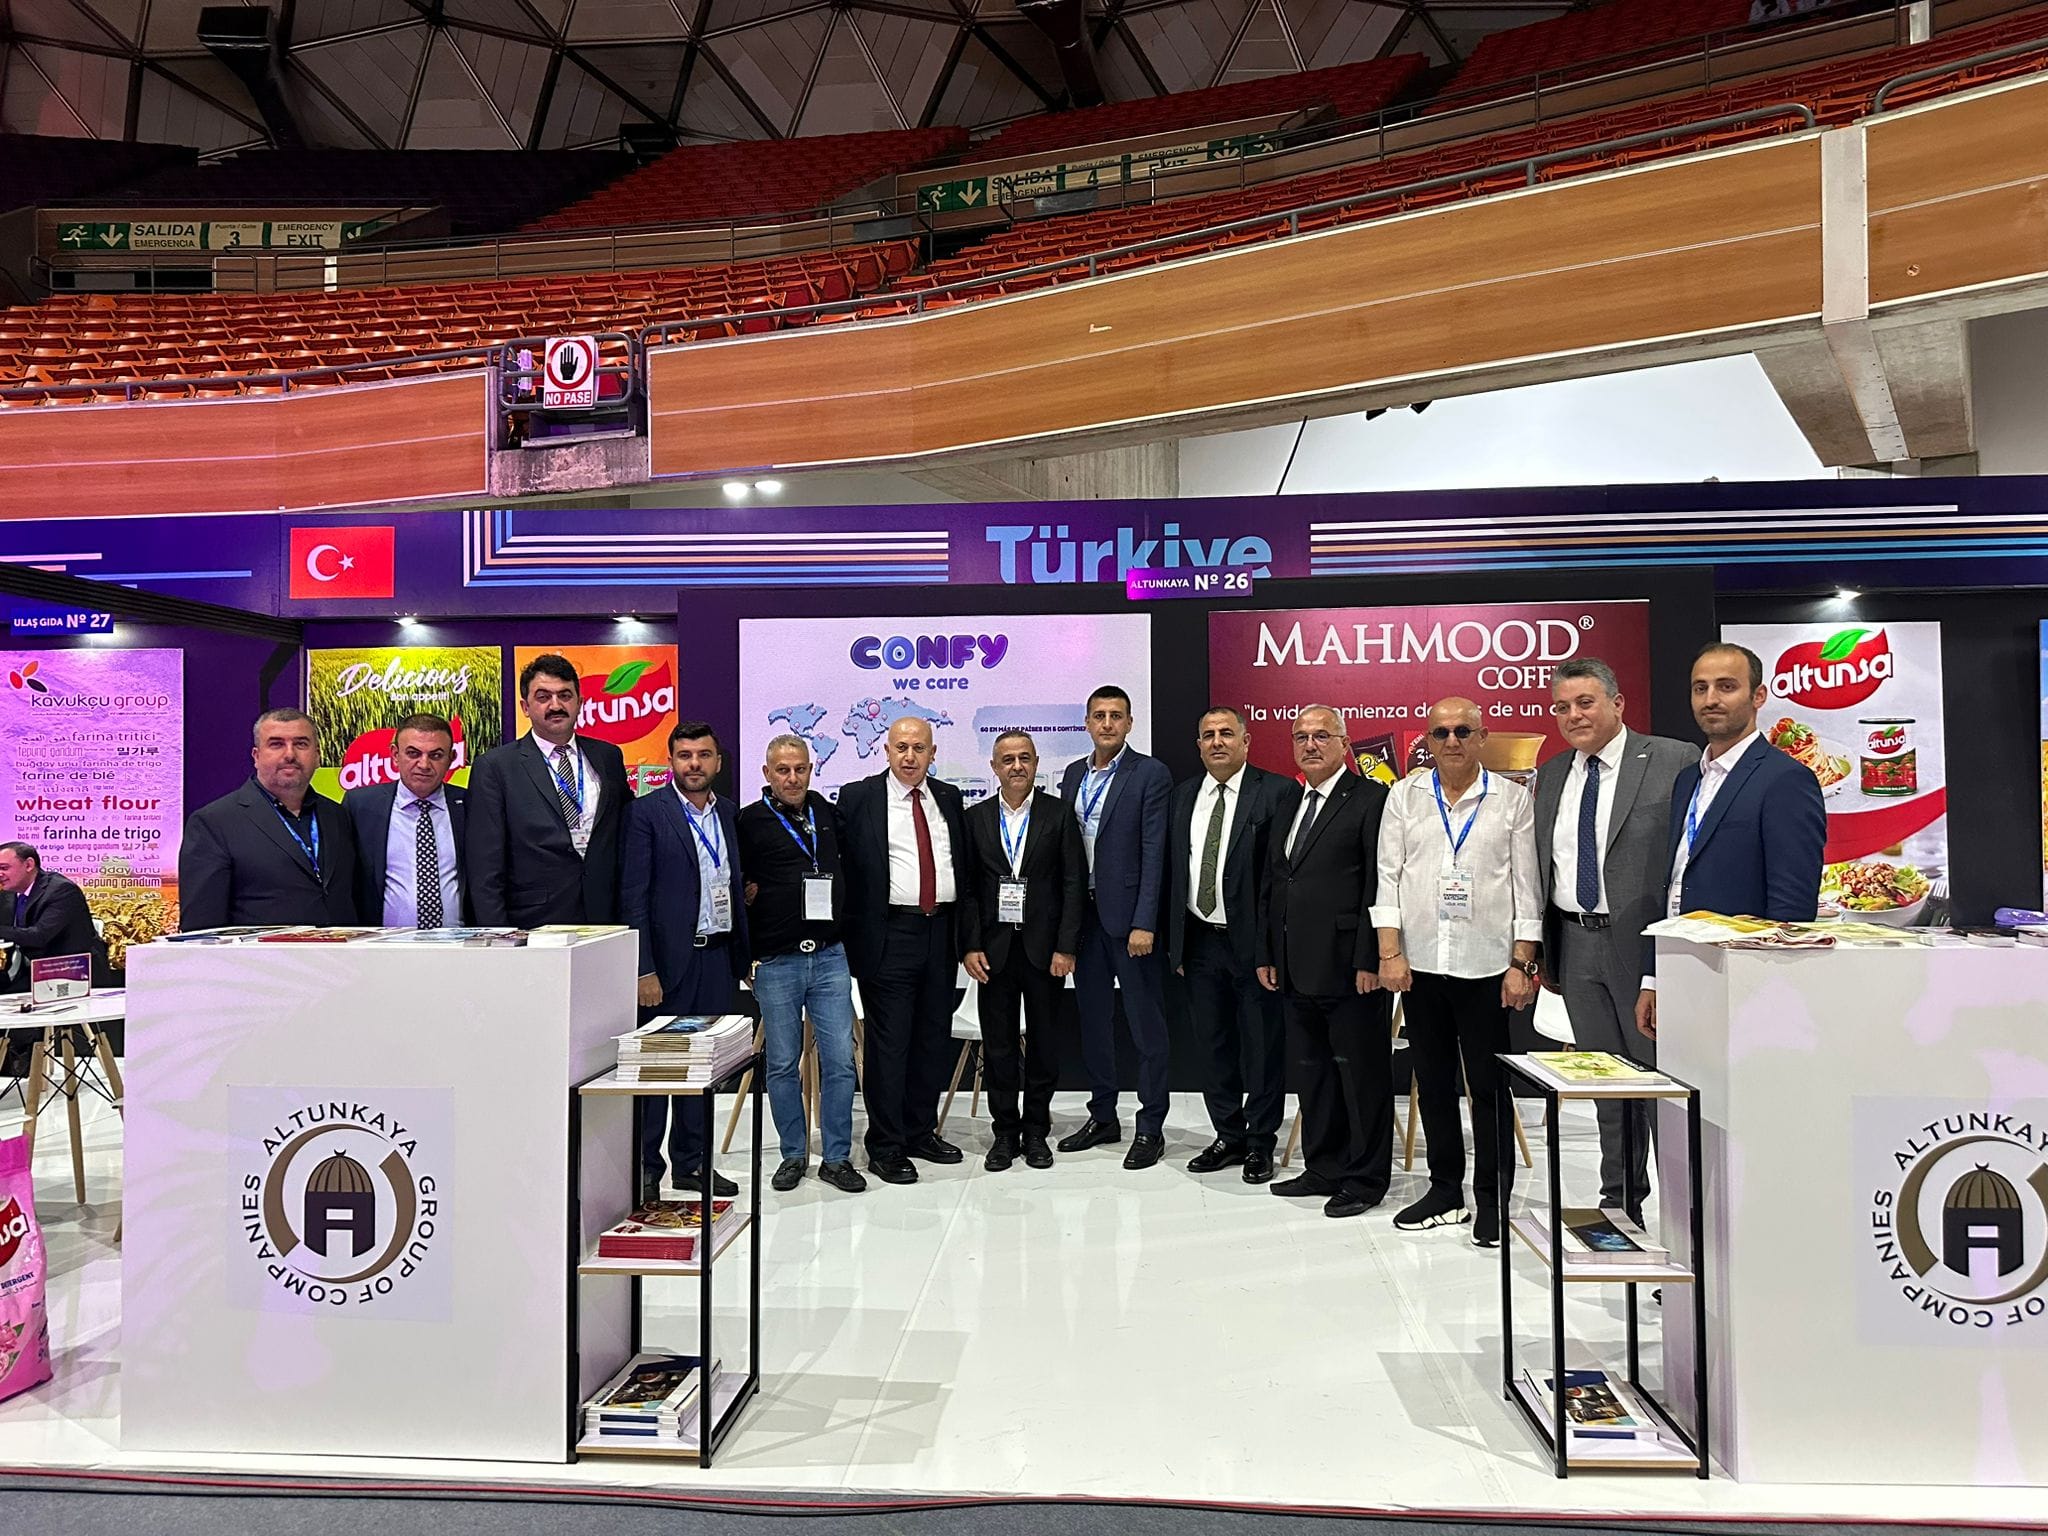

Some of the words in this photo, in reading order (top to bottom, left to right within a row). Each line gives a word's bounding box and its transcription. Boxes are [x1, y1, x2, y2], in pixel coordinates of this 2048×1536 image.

[992, 169, 1053, 190] SALIDA
[1087, 169, 1098, 184] 4
[134, 224, 195, 236] SALIDA
[277, 223, 335, 231] EMERGENCY
[134, 239, 195, 248] EMERGENCIA
[230, 231, 240, 246] 3
[287, 234, 323, 246] EXIT
[545, 393, 561, 405] NO
[563, 391, 591, 404] PASE
[1130, 579, 1190, 589] ALTUNKAYA
[1223, 573, 1249, 590] 26
[14, 618, 38, 628] ULAŞ
[39, 618, 63, 627] GIDA
[90, 613, 111, 628] 27
[1253, 619, 1580, 667] MAHMOOD
[850, 633, 1009, 670] CONFY
[336, 655, 472, 697] Delicious
[1477, 665, 1556, 690] COFF
[1771, 652, 1893, 698] altunsa
[892, 678, 921, 690] we
[925, 677, 969, 690] care
[31, 694, 110, 710] kavukçu
[114, 695, 168, 710] group
[573, 686, 674, 730] ltunsa
[1333, 703, 1408, 719] mienza
[1489, 701, 1513, 717] de
[1519, 703, 1543, 716] un
[72, 731, 113, 741] farina
[118, 731, 156, 741] tritici
[1867, 733, 1905, 750] altunsa
[137, 760, 162, 768] trigo
[1415, 748, 1435, 765] 3in
[339, 741, 465, 790] altua
[22, 771, 65, 780] farine
[69, 771, 88, 780] de
[93, 770, 115, 780] blé
[16, 795, 93, 810] wheat
[102, 795, 161, 810] flour
[14, 814, 60, 823] buğday
[44, 826, 97, 840] farinha
[101, 826, 120, 840] de
[124, 826, 161, 842] trigo
[64, 853, 83, 862] de
[87, 853, 109, 862] blé
[83, 878, 118, 889] tepung
[121, 878, 160, 889] gandum
[88, 892, 109, 900] 가루
[262, 1102, 418, 1158] ALTUNKAYA
[1894, 1112, 2048, 1170] ALTUNKAY
[399, 1175, 438, 1278] GROUP
[242, 1174, 347, 1305] COMPANIES
[1872, 1189, 1993, 1328] COMPANIES
[358, 1276, 393, 1303] OF
[2006, 1297, 2045, 1326] OF
